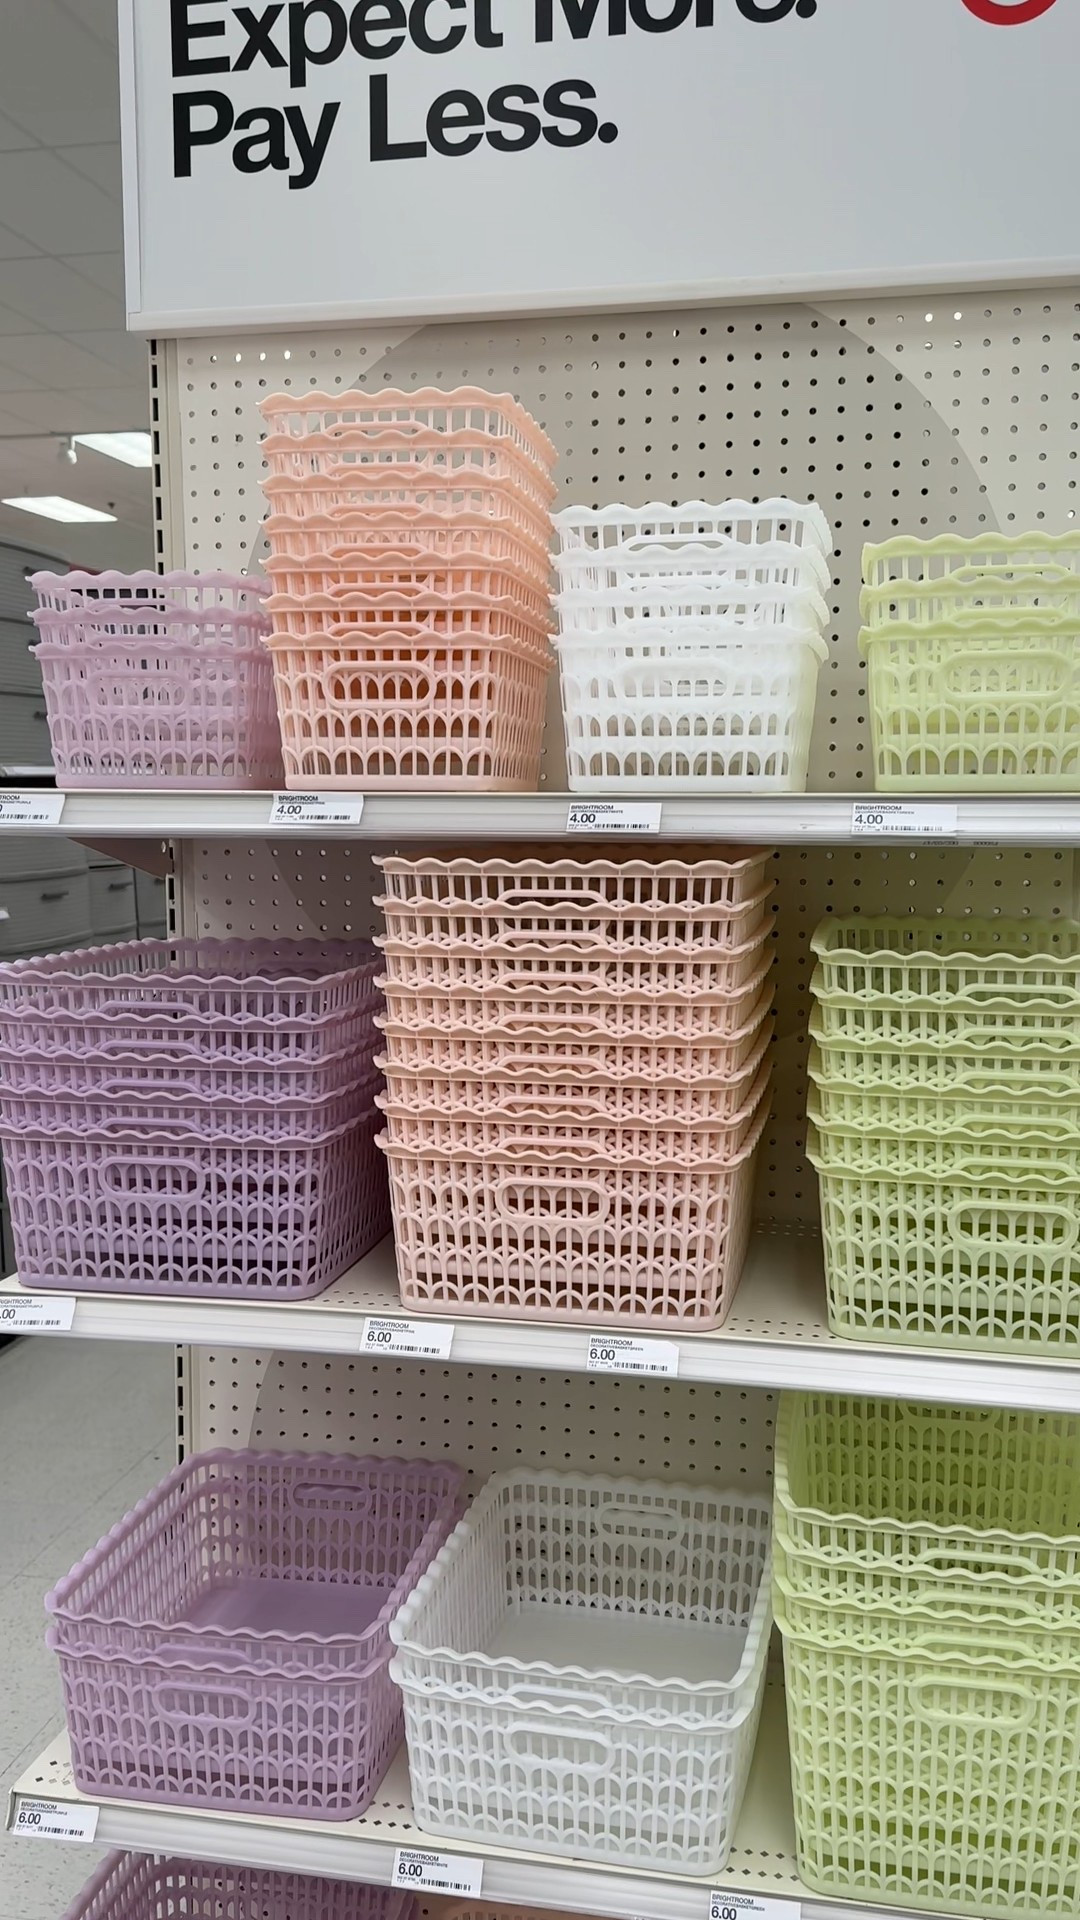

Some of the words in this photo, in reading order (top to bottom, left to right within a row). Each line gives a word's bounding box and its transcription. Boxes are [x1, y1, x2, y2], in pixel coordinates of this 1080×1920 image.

[172, 90, 341, 190] Pay
[369, 73, 619, 162] Less.
[277, 805, 302, 815] 4.00
[569, 813, 596, 823] 4.00
[854, 814, 884, 824] 4.00
[369, 1320, 409, 1329] BRIGHTROOM
[367, 1330, 392, 1343] 6.00
[591, 1337, 633, 1346] BRIGHTROOM
[589, 1348, 616, 1361] 6.00
[21, 1801, 58, 1810] BRIGHTROOM
[18, 1811, 42, 1825] 6.00
[399, 1850, 440, 1862] BRIGHTROOM
[398, 1862, 423, 1877] 6.00
[711, 1893, 754, 1905] BRIGHTROOM
[711, 1905, 737, 1920] 6.00
